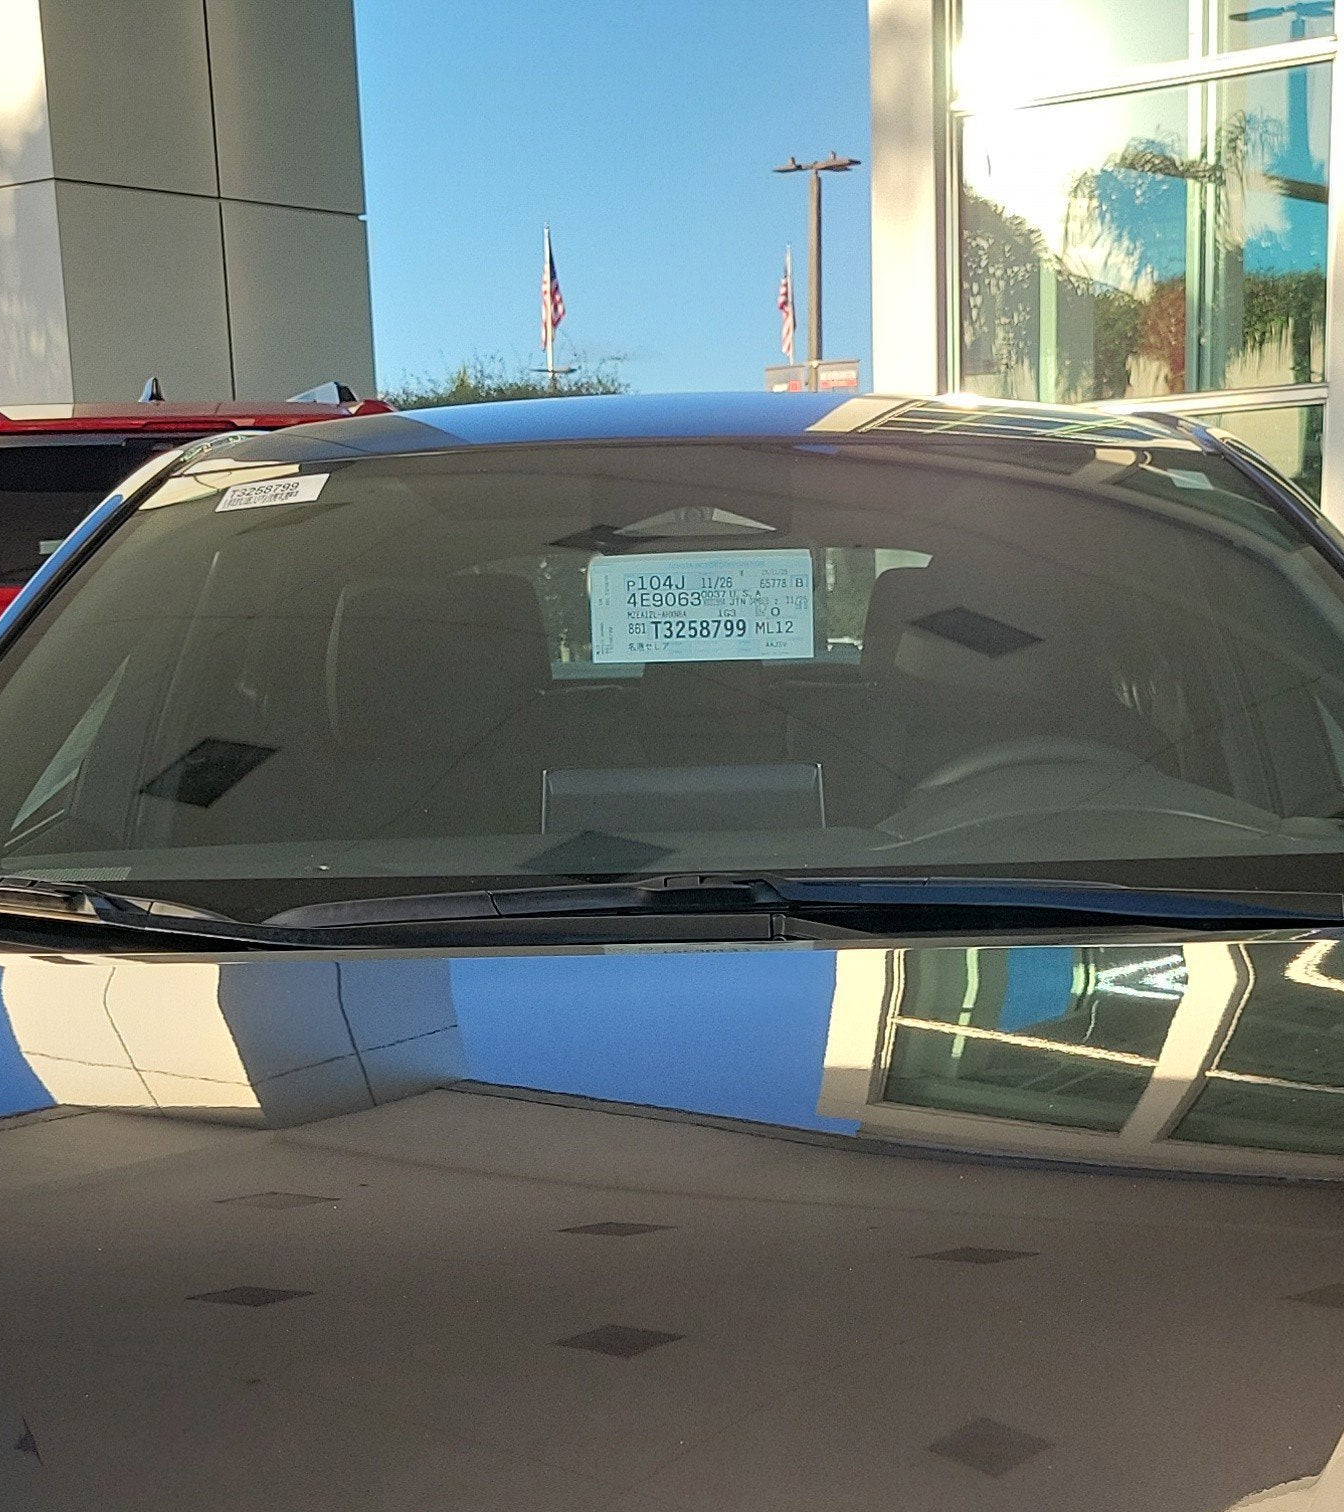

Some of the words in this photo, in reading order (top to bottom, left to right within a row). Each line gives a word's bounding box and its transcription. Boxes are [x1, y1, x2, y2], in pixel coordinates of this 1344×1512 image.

[230, 482, 300, 498] T3258799
[626, 575, 685, 591] P104J
[701, 577, 733, 589] 11/26
[795, 577, 804, 588] B
[627, 591, 702, 608] 4E9063
[628, 622, 646, 635] 861
[651, 619, 746, 639] T3258799
[755, 620, 794, 634] ML12
